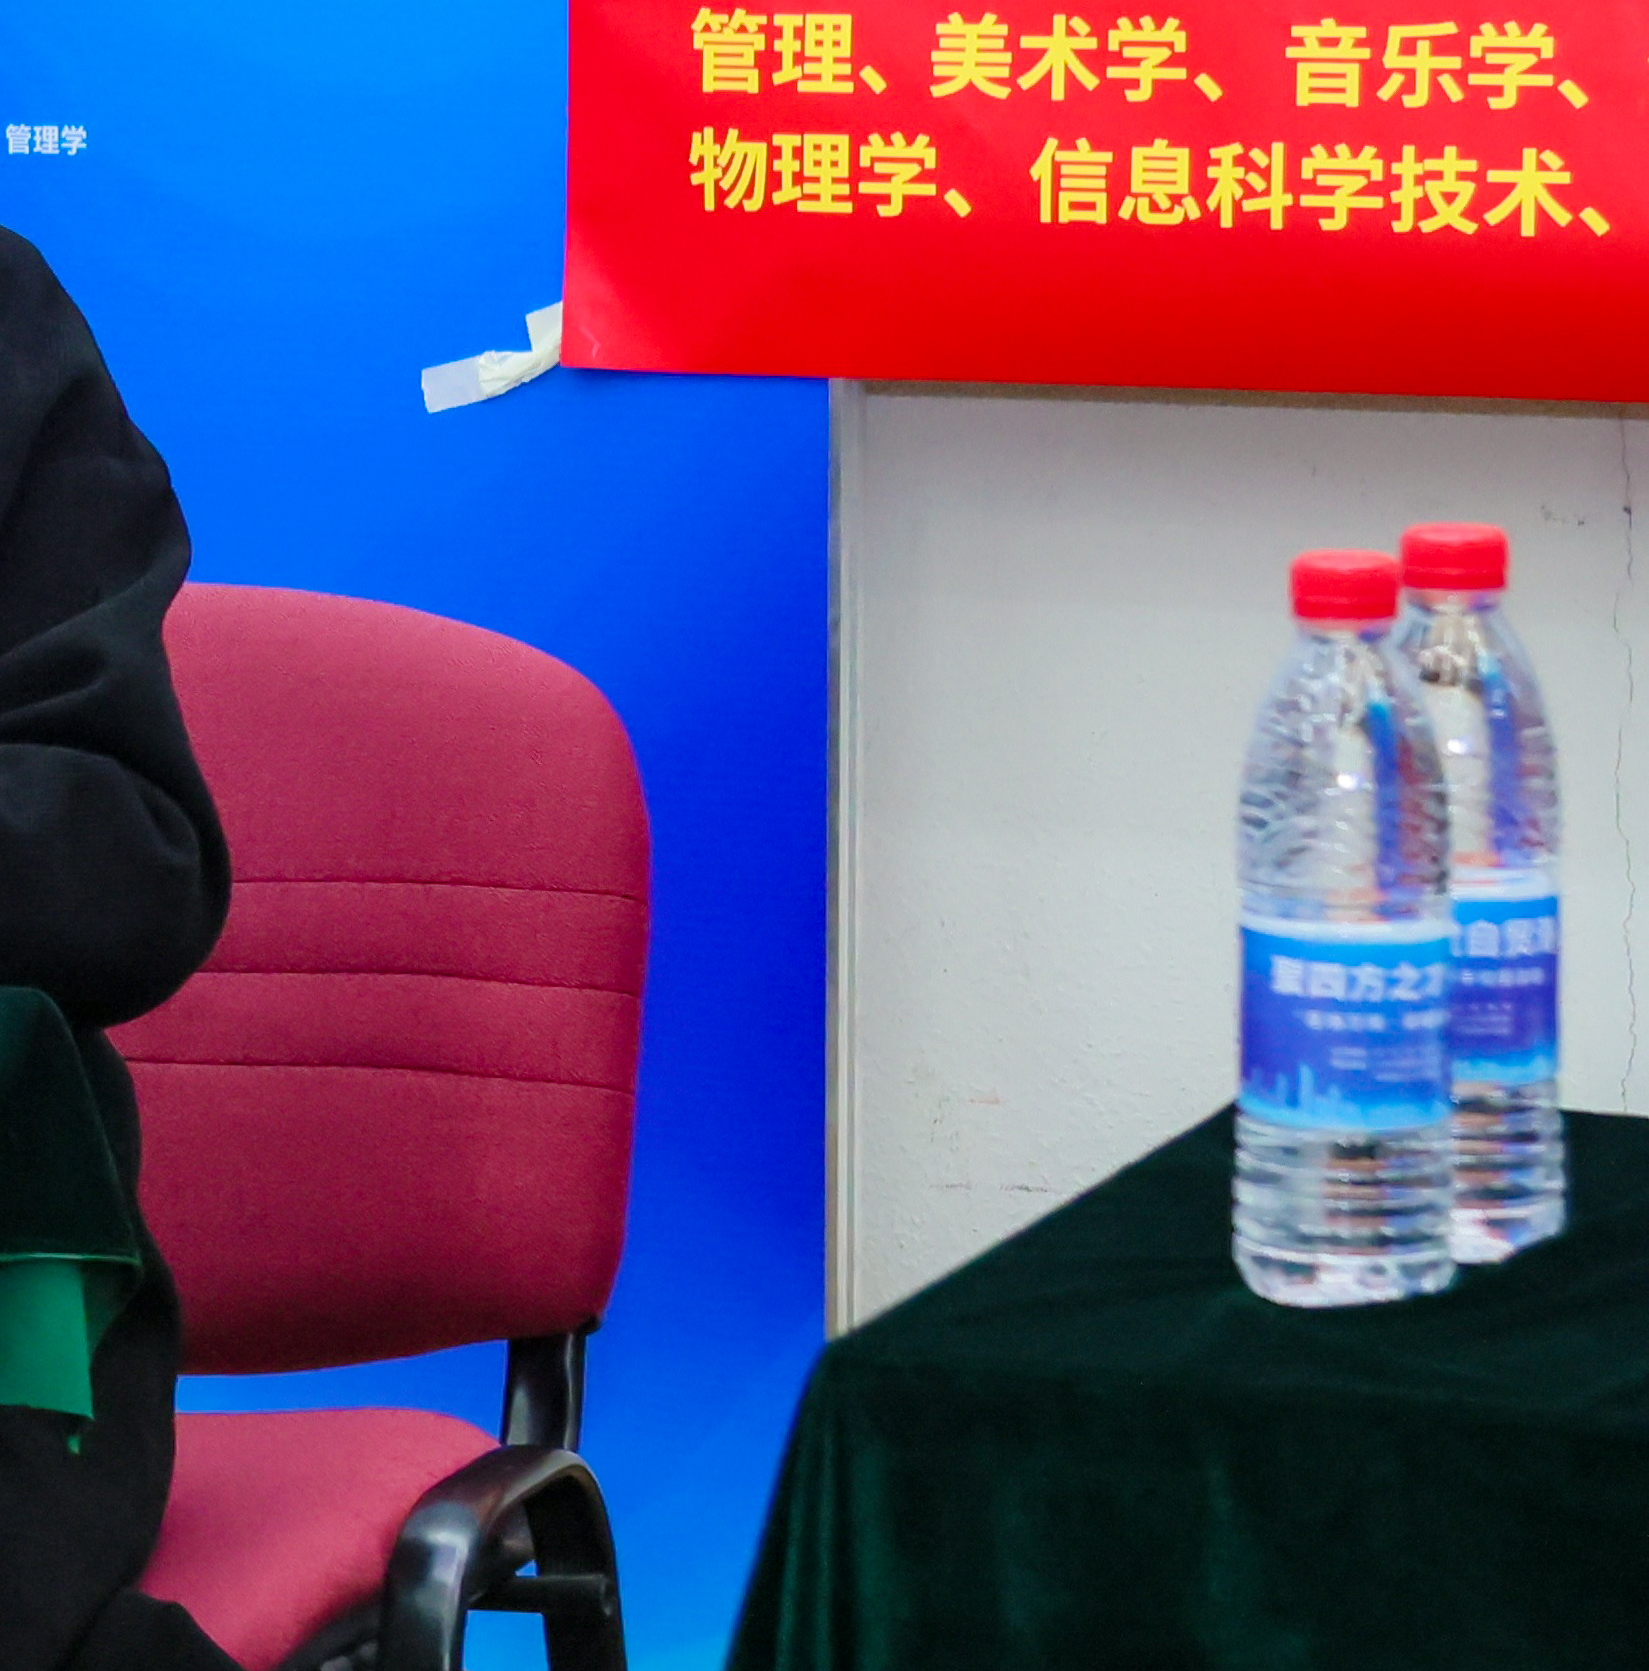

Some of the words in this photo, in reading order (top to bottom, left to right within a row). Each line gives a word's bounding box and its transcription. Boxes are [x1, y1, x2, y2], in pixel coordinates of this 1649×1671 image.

[691, 7, 1589, 109] 管理、美术学、音乐学、
[689, 127, 1610, 237] 物理学、信息科学技术、
